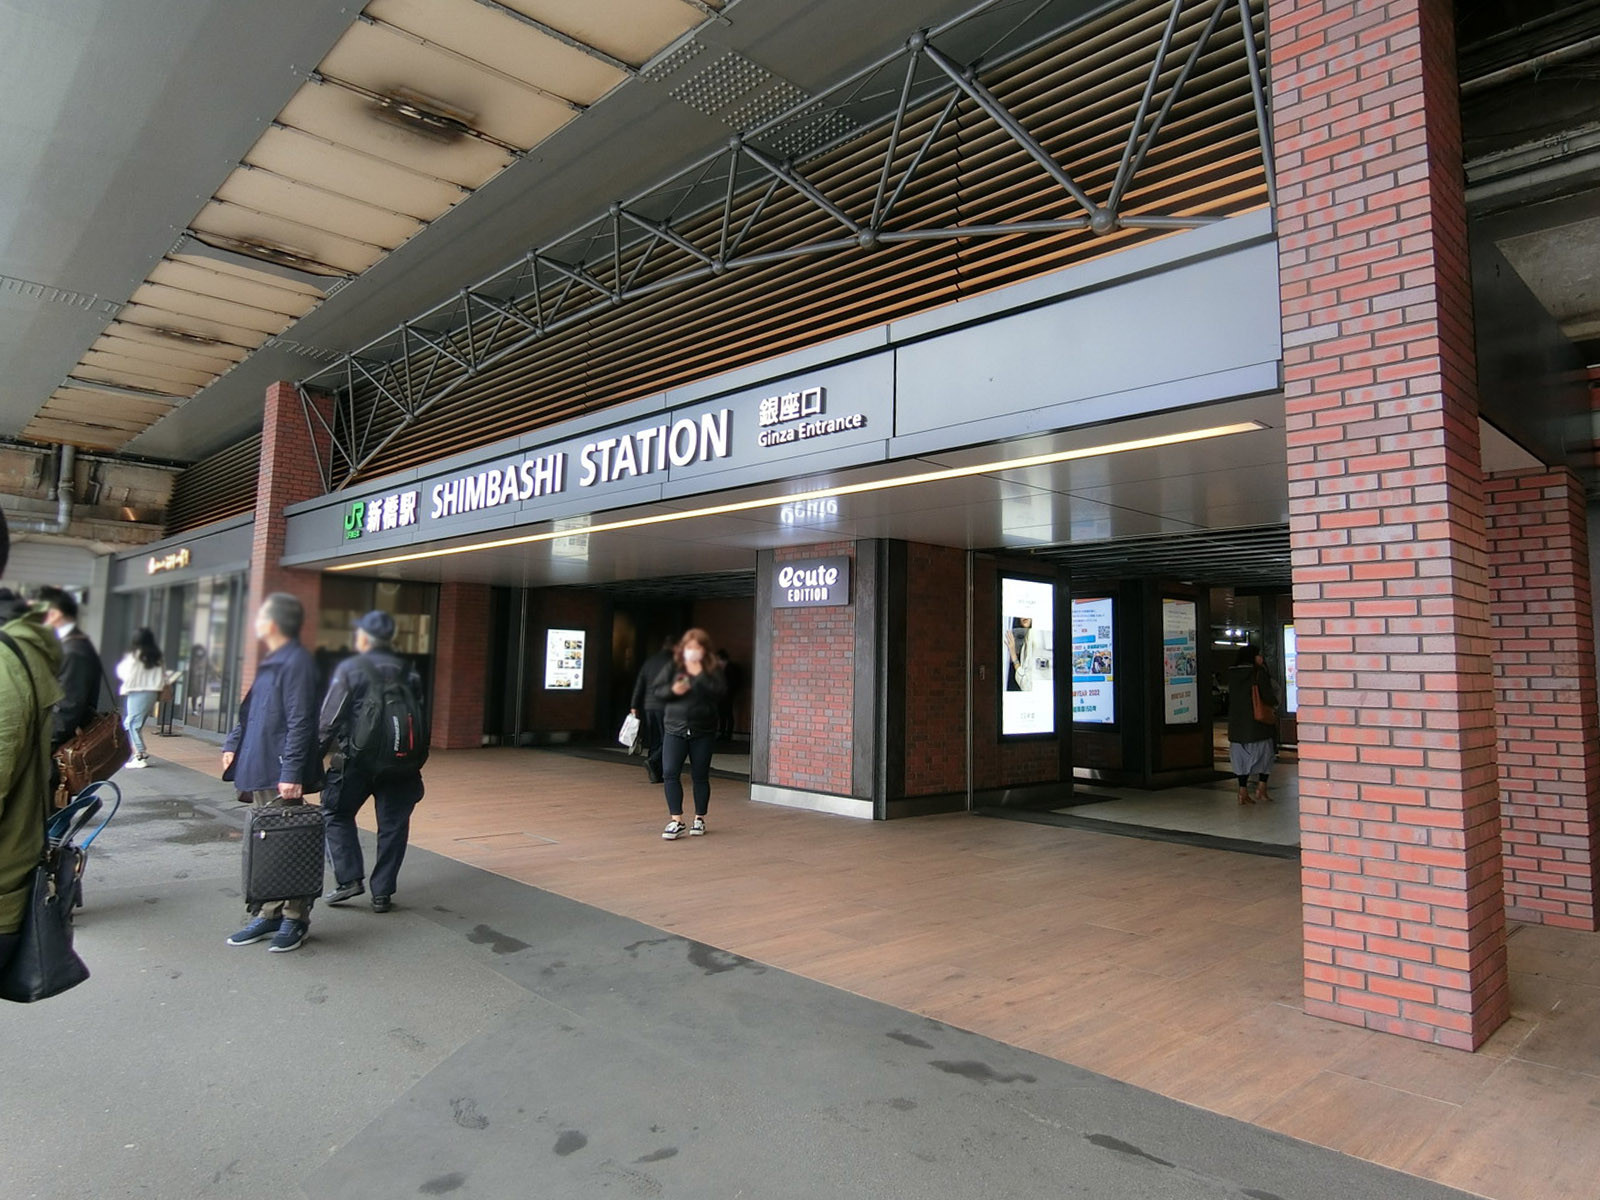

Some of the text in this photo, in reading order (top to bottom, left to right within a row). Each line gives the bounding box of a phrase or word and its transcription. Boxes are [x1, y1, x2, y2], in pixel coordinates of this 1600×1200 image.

[758, 386, 823, 427] 銀座口
[757, 413, 864, 447] Ginza Entrance
[431, 408, 731, 520] SHIMBASHI STATION
[344, 501, 365, 530] JR
[366, 490, 418, 533] 新橋駅
[778, 564, 839, 588] ecute
[787, 587, 829, 602] EDITION
